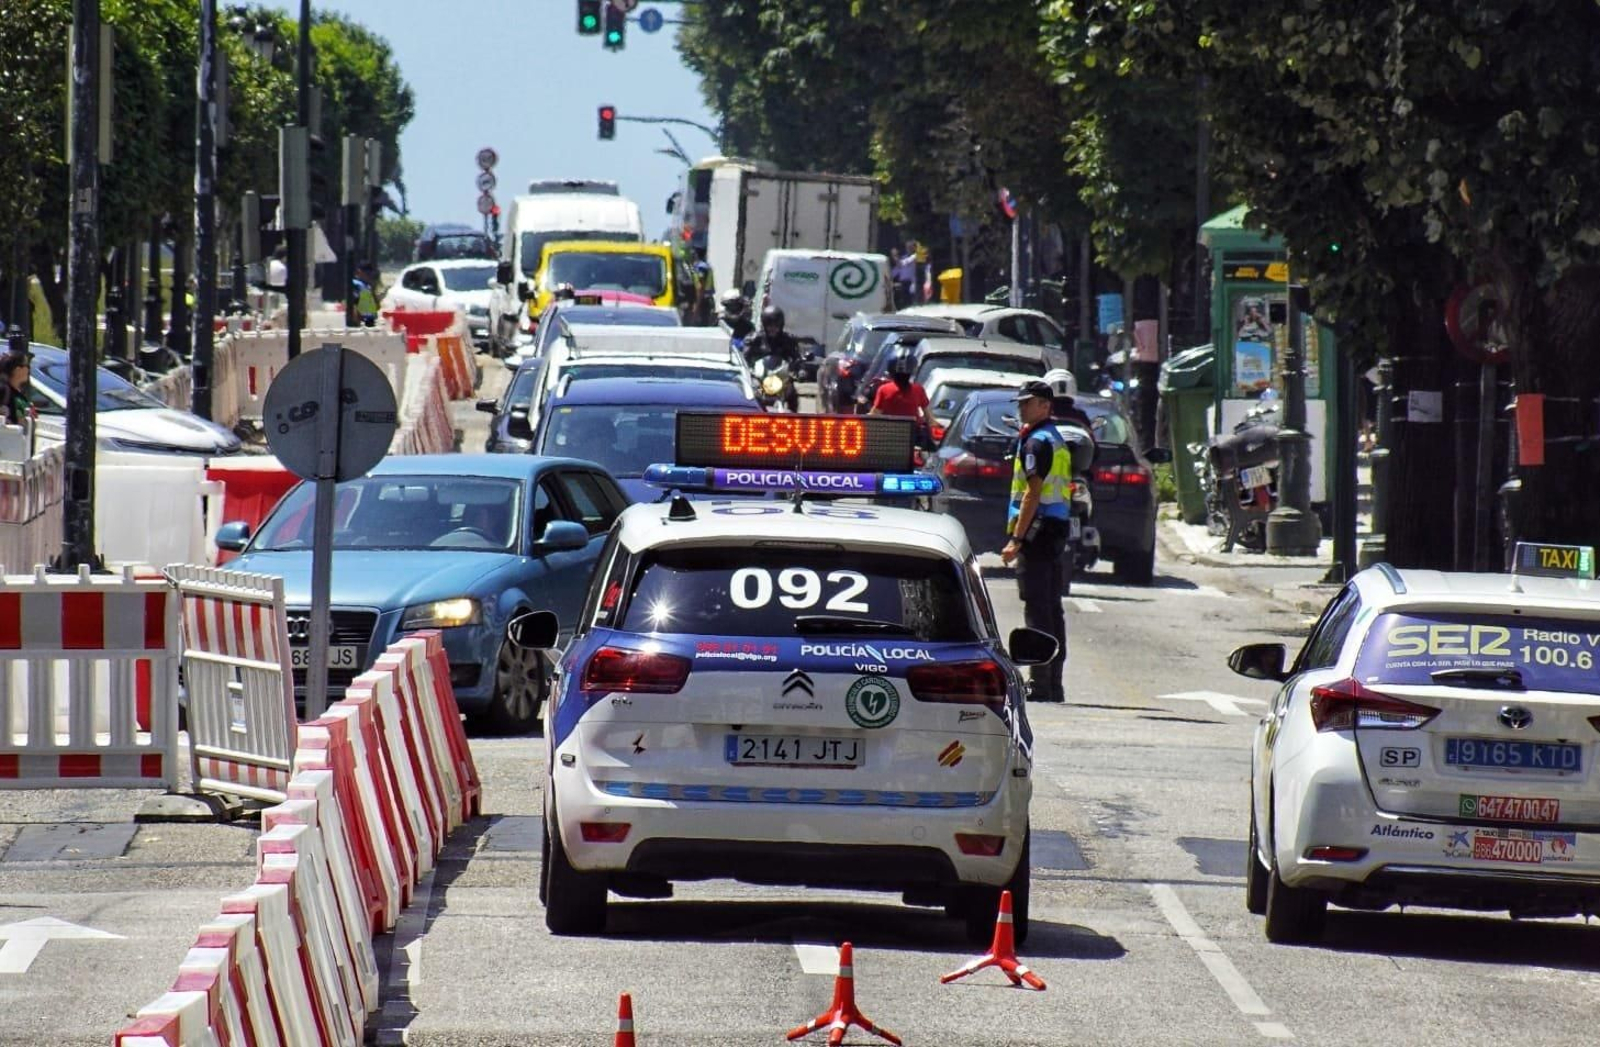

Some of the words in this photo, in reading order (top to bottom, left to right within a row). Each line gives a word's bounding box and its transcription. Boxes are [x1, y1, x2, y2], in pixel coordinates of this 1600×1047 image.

[724, 417, 862, 455] DESVIO
[726, 471, 795, 487] POLICÍA
[808, 475, 864, 488] LOCAL
[1540, 548, 1579, 570] TAXI
[730, 567, 869, 613] 092
[1387, 624, 1511, 658] SER
[1523, 628, 1581, 645] Radio
[801, 643, 868, 658] POLICÍA
[883, 648, 936, 661] LOCAL
[1519, 645, 1593, 670] 100.6
[855, 663, 888, 673] VIGO
[742, 738, 801, 760] 2141
[813, 740, 858, 761] JTJ
[1384, 750, 1416, 765] SP
[1461, 741, 1522, 765] 9165
[1532, 744, 1577, 768] KTD
[1371, 824, 1435, 840] Atlántico
